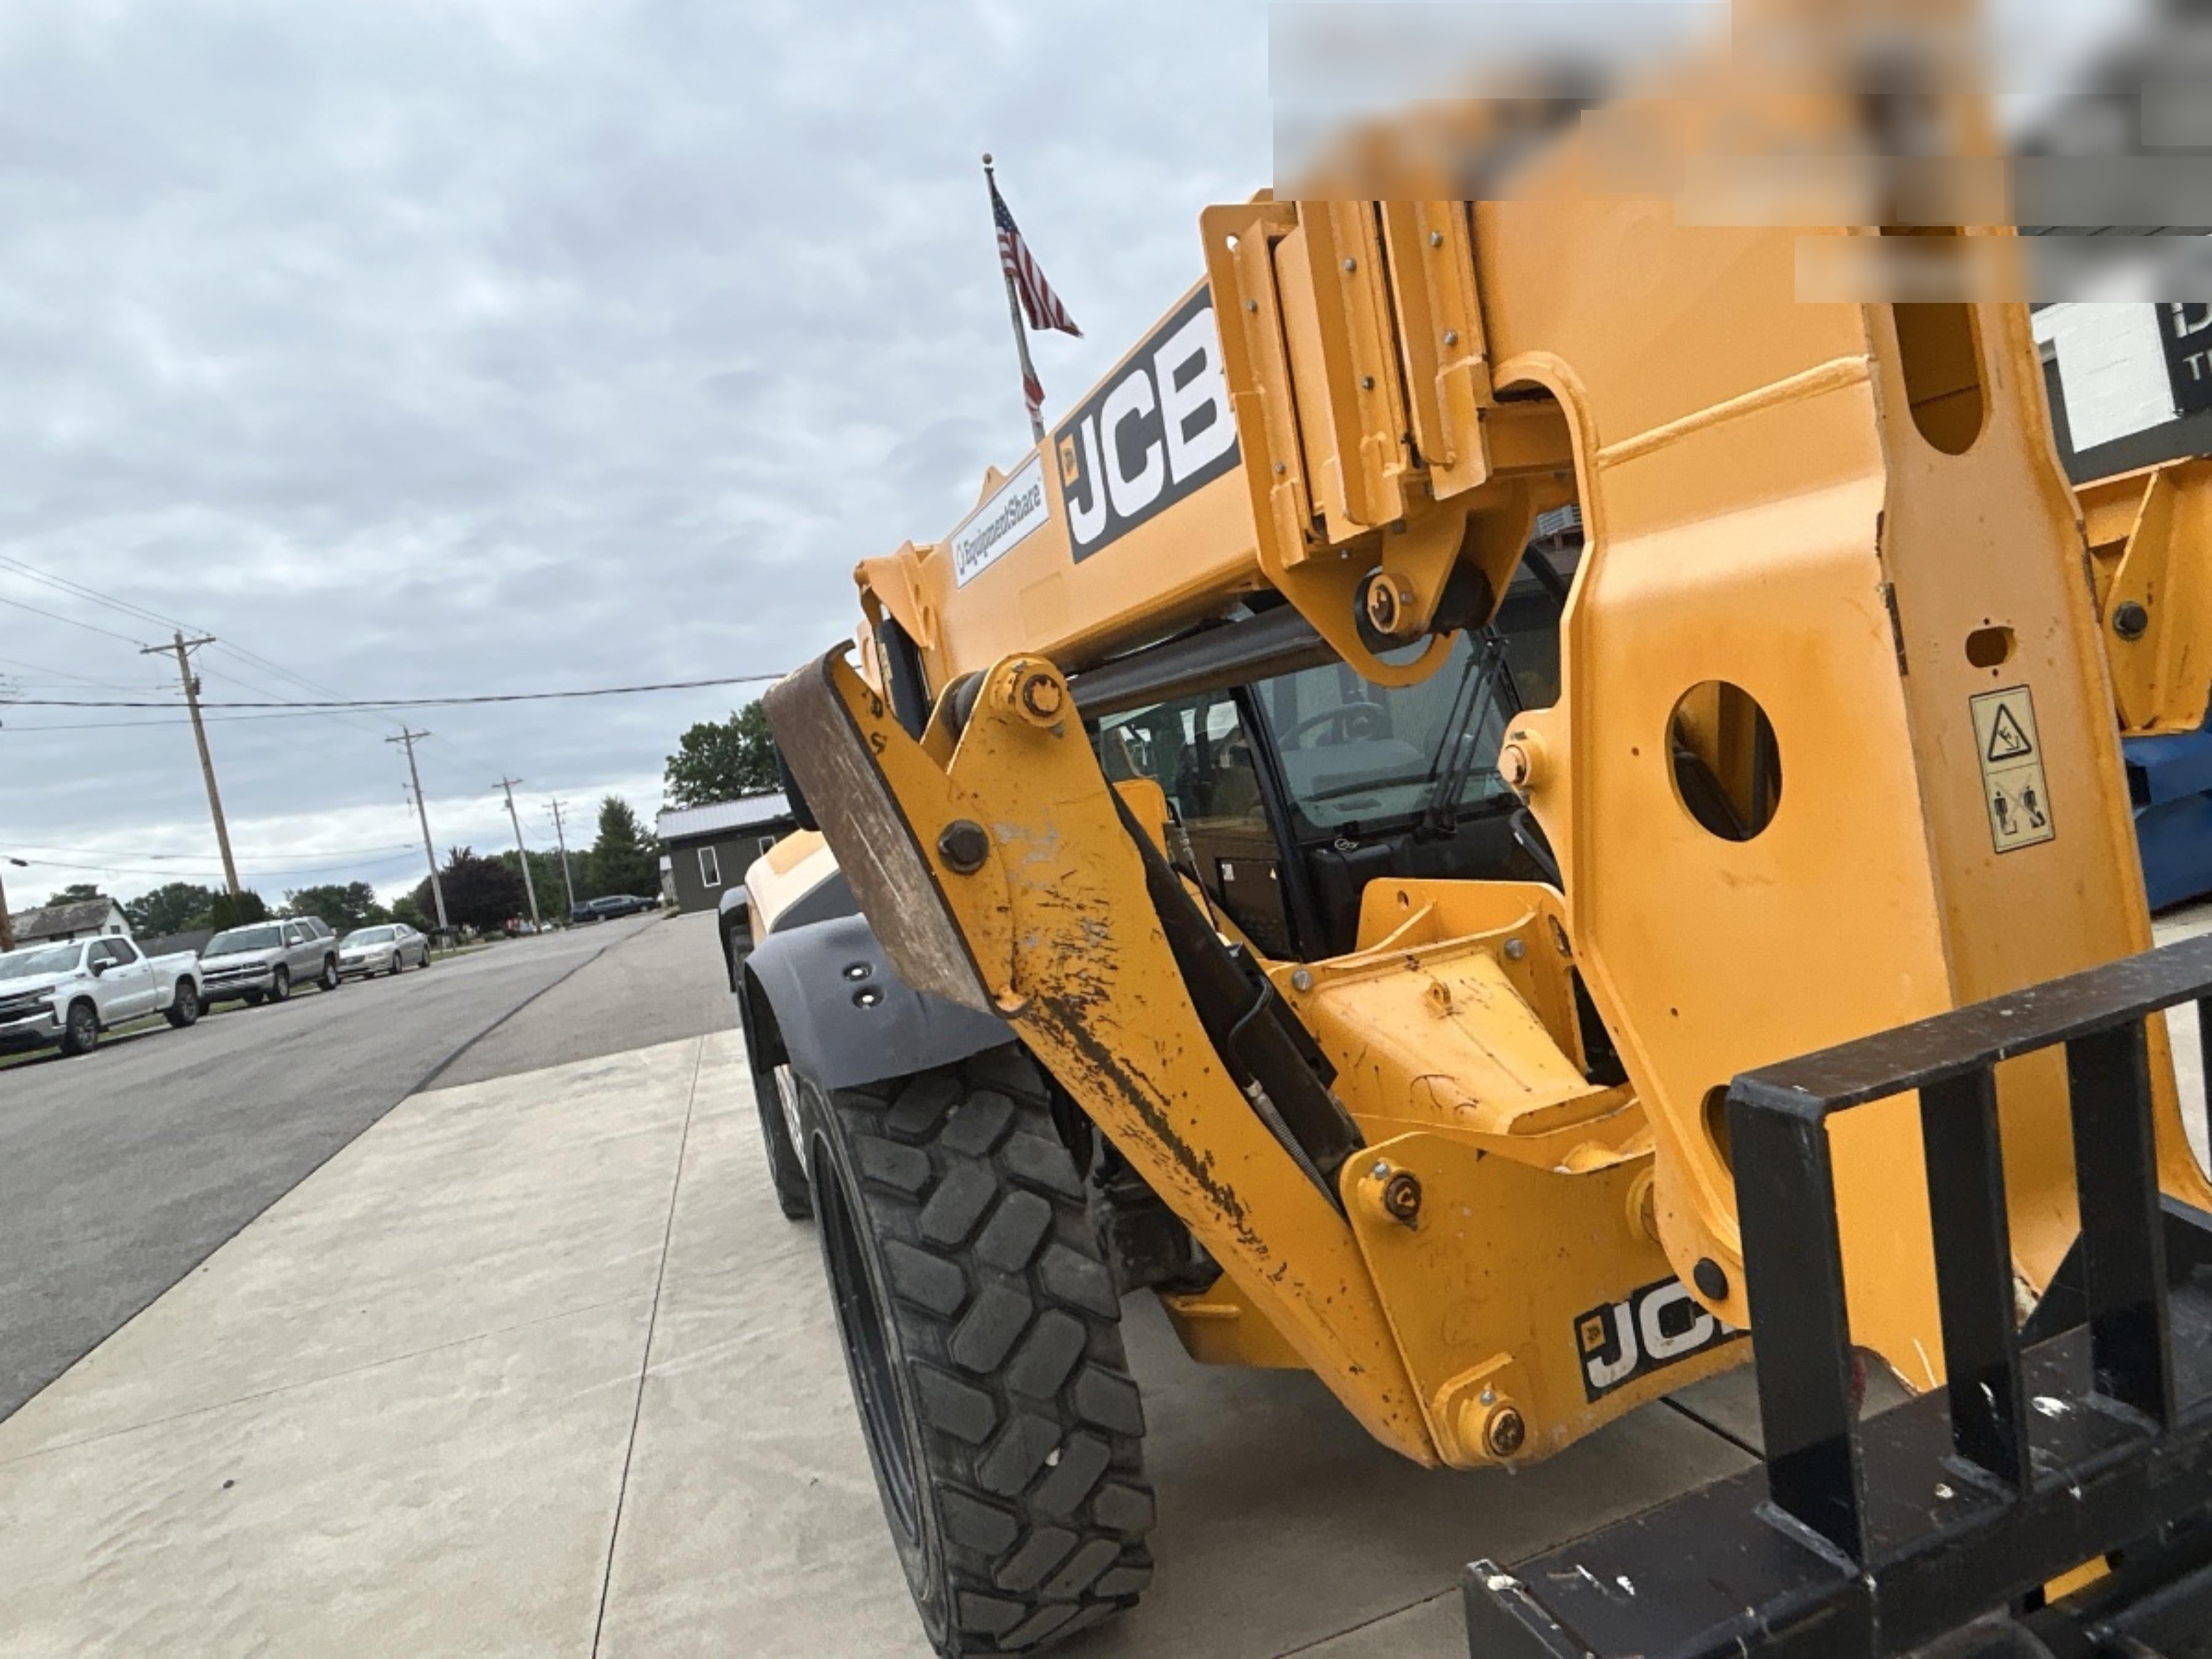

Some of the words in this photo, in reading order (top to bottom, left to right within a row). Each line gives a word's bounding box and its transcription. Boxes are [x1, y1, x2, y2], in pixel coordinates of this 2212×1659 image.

[1068, 307, 1237, 544] JCB
[963, 484, 1041, 567] EquipmentShare
[1586, 1281, 1736, 1387] JC
